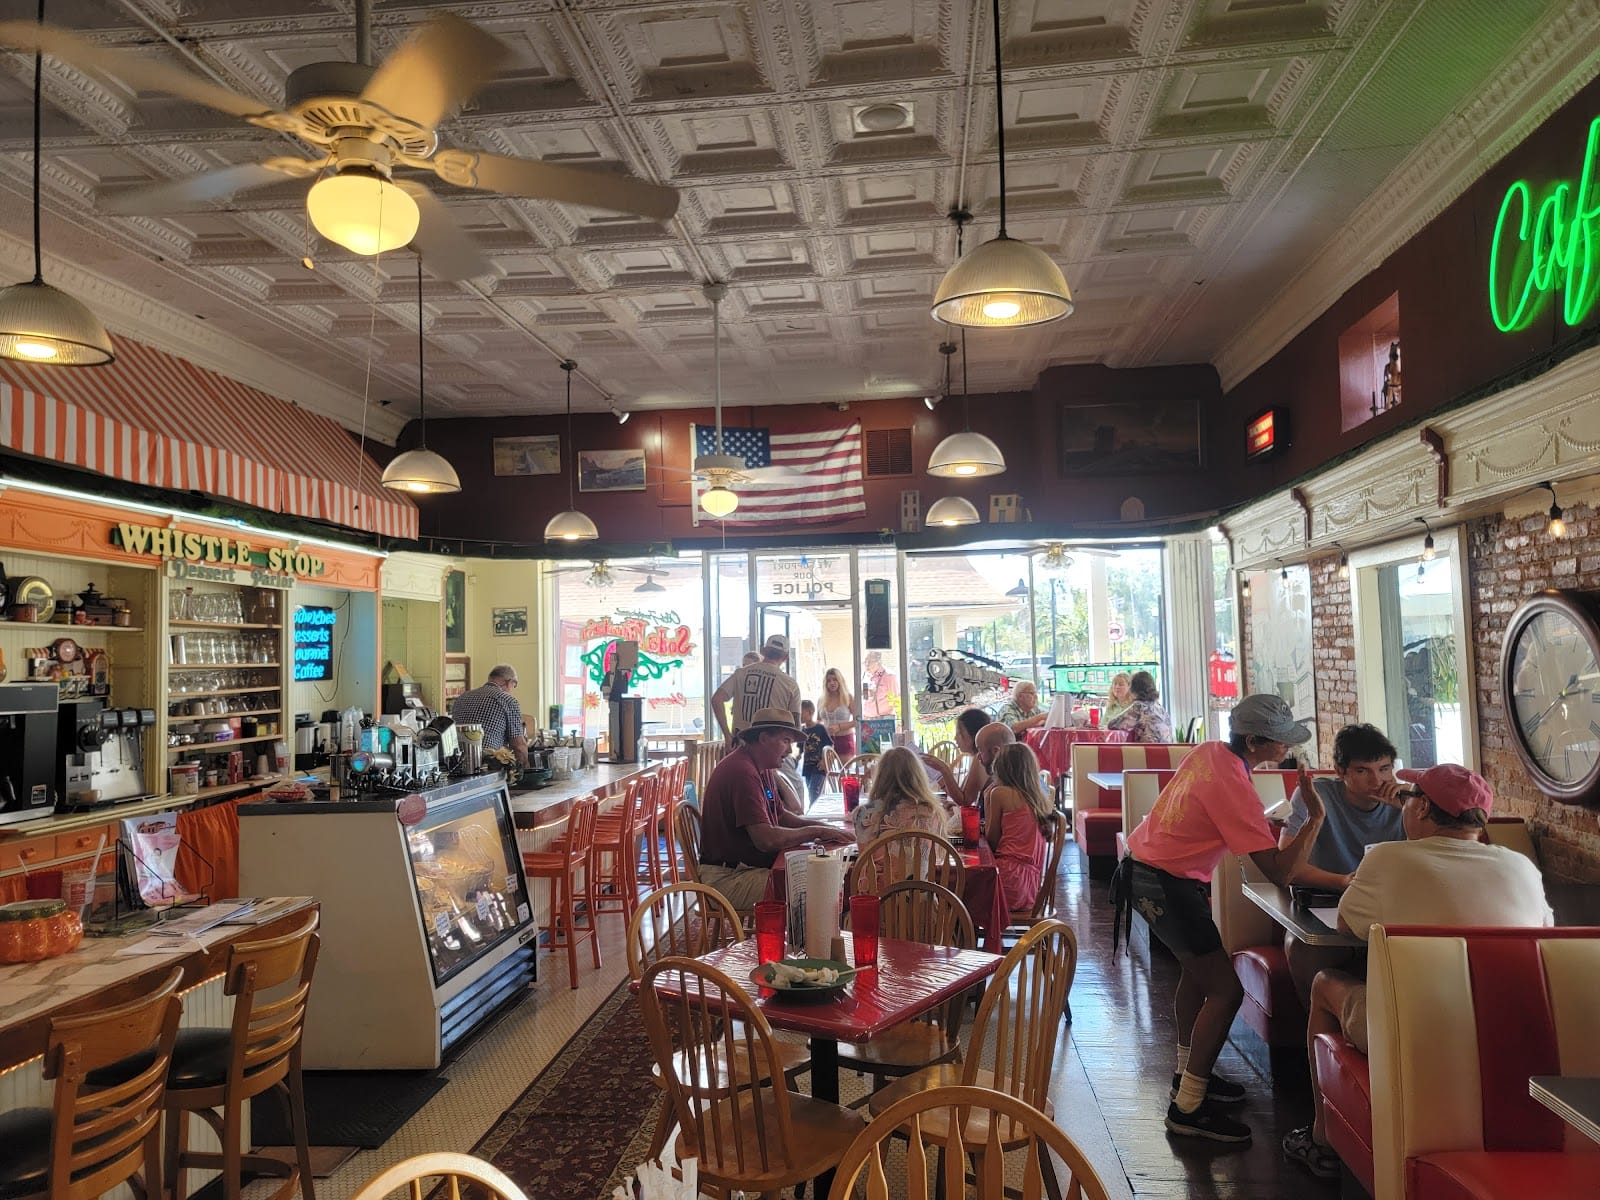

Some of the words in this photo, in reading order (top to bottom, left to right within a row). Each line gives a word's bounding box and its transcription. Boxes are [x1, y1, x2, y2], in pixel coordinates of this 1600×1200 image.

[118, 523, 252, 566] WHISTLE
[268, 547, 323, 577] STOP
[173, 559, 236, 583] Dessert
[251, 570, 296, 589] Parlor
[294, 663, 325, 680] Coffee
